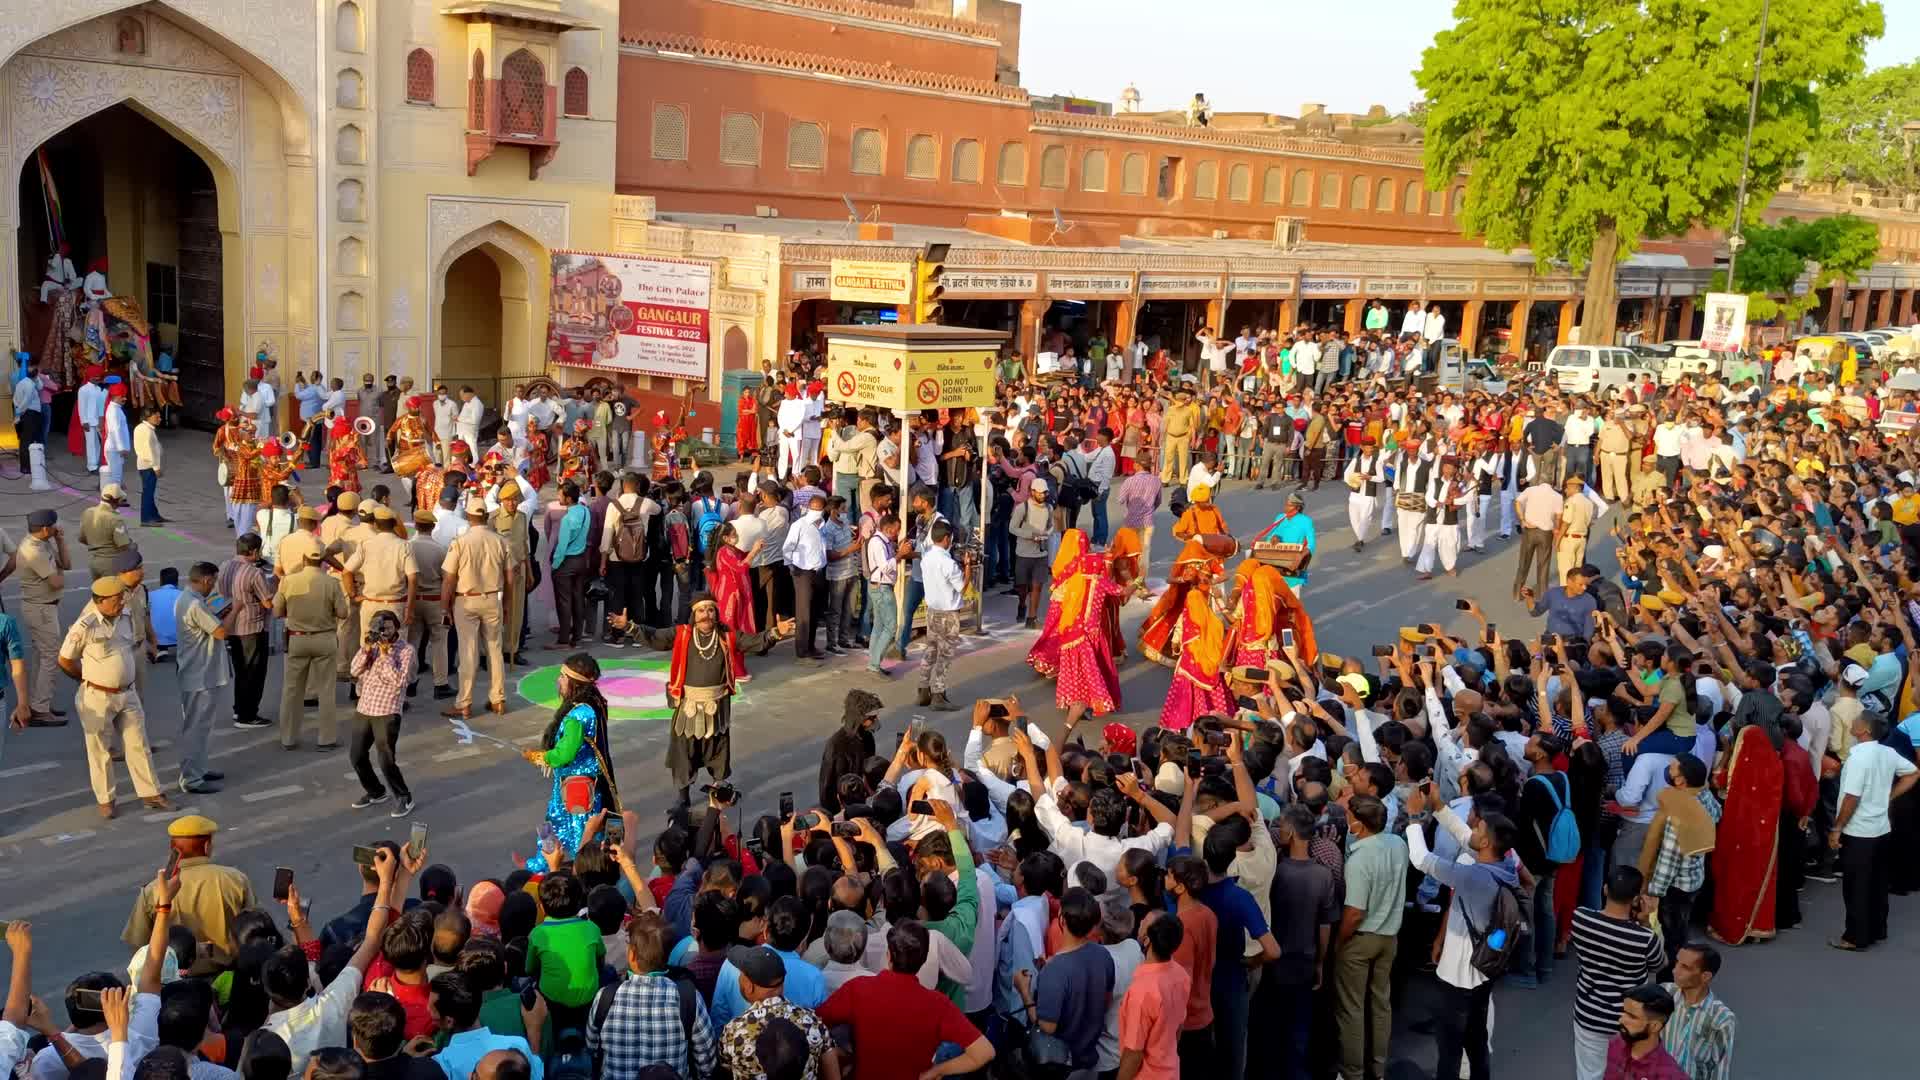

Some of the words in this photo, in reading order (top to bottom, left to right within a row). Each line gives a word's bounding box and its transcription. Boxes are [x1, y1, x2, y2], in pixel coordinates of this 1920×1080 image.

[638, 283, 654, 291] The
[656, 285, 672, 294] City
[676, 287, 705, 297] Palace
[638, 306, 702, 326] GANGAUR
[636, 324, 675, 337] FESTIVAL
[677, 328, 701, 340] 2022
[858, 374, 867, 382] DO
[868, 376, 880, 384] NOT
[942, 378, 953, 386] DO
[954, 377, 968, 386] NOT
[858, 383, 875, 391] HONK
[876, 385, 894, 393] YOUR
[942, 387, 963, 395] HONK
[963, 385, 984, 394] YOUR
[857, 391, 875, 400] HORN
[942, 395, 963, 403] HORN
